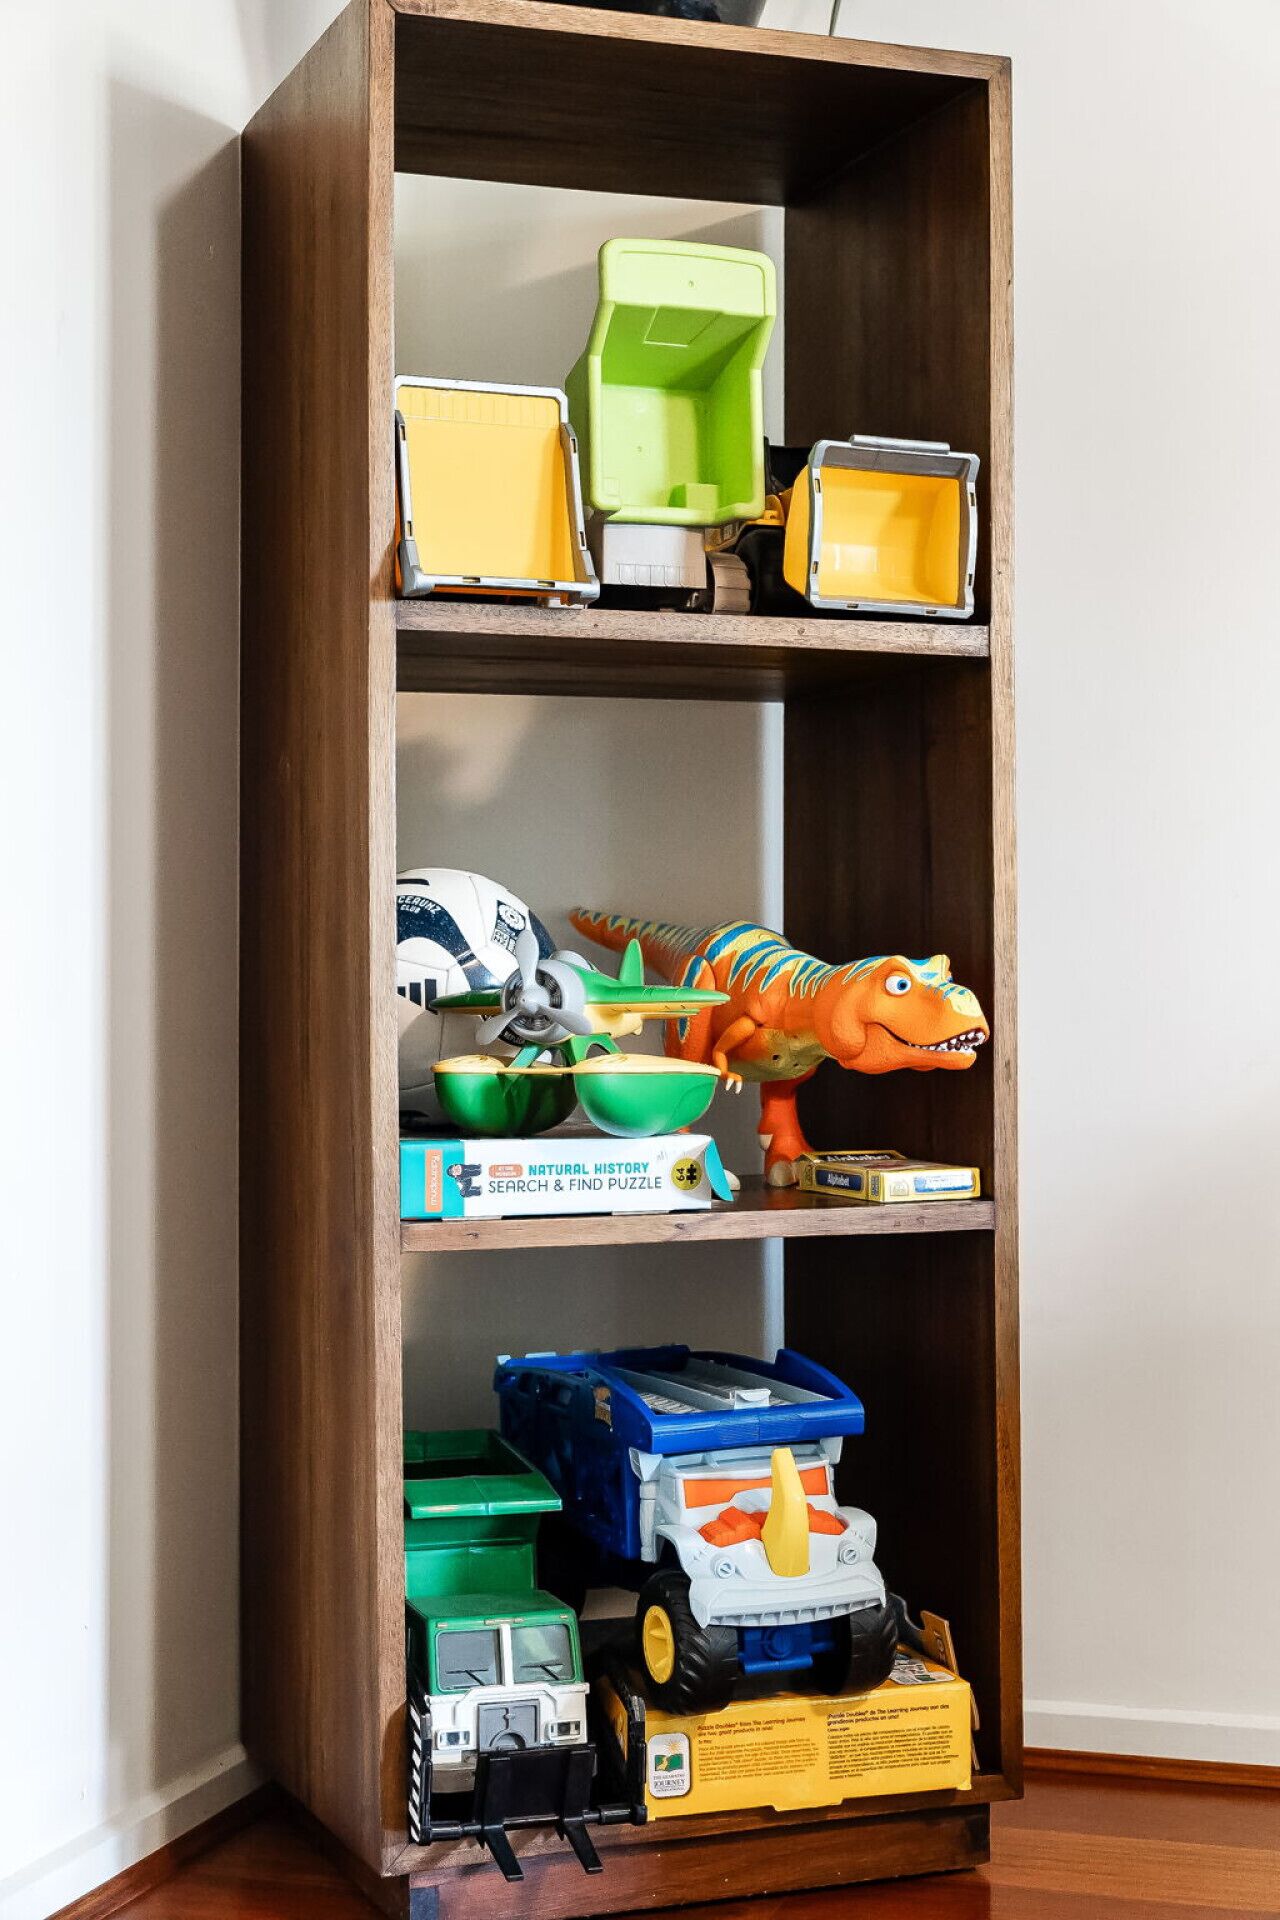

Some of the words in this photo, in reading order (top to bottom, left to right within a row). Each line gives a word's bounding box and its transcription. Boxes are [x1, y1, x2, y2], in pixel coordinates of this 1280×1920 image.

[398, 895, 442, 915] CEAUNZ
[528, 1164, 589, 1177] NATURAL
[594, 1162, 649, 1175] HISTORY
[676, 1167, 686, 1182] 64
[489, 1179, 548, 1193] SEARCH
[554, 1179, 564, 1191] &
[570, 1178, 603, 1190] FIND
[609, 1176, 662, 1190] PUZZLE
[654, 1779, 685, 1788] JOURNEY
